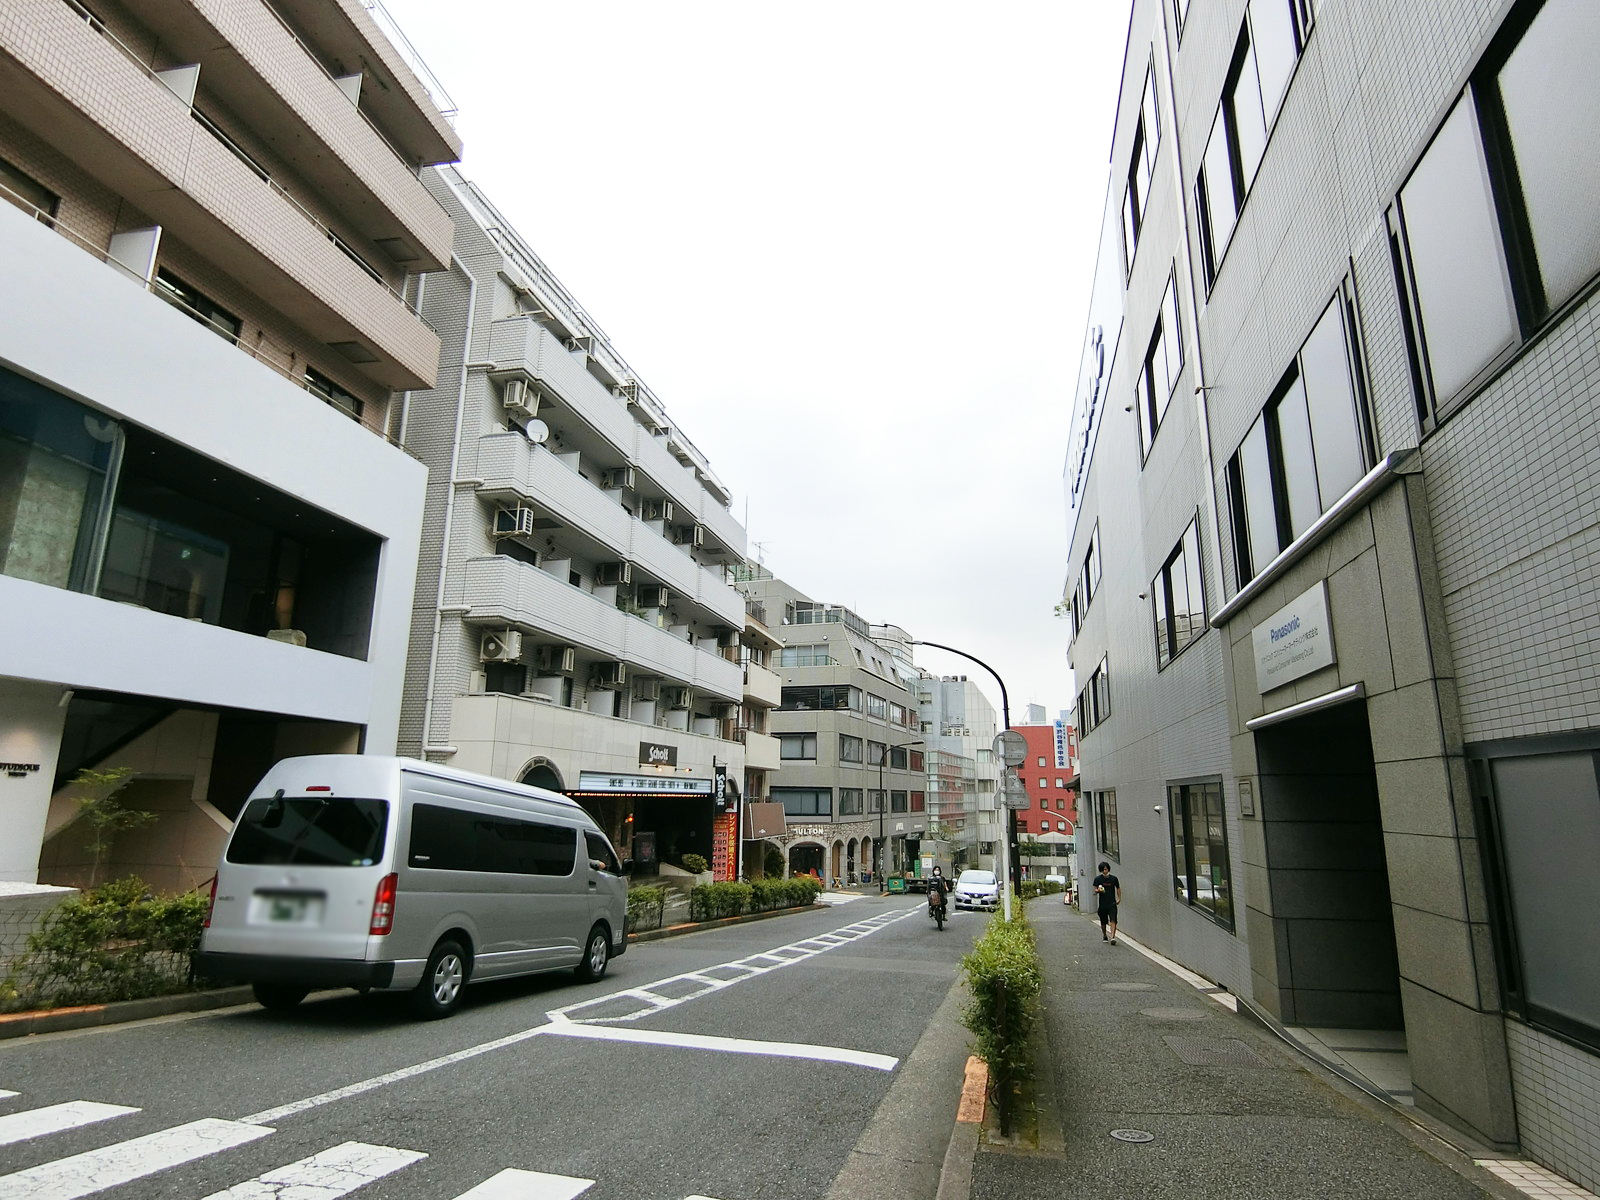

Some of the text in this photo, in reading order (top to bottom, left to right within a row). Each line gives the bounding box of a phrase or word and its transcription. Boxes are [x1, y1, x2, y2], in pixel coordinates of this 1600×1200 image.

[1270, 614, 1301, 643] Panasonic
[648, 745, 669, 762] Schott
[0, 762, 40, 771] TUDIOUS
[716, 773, 725, 806] Schott
